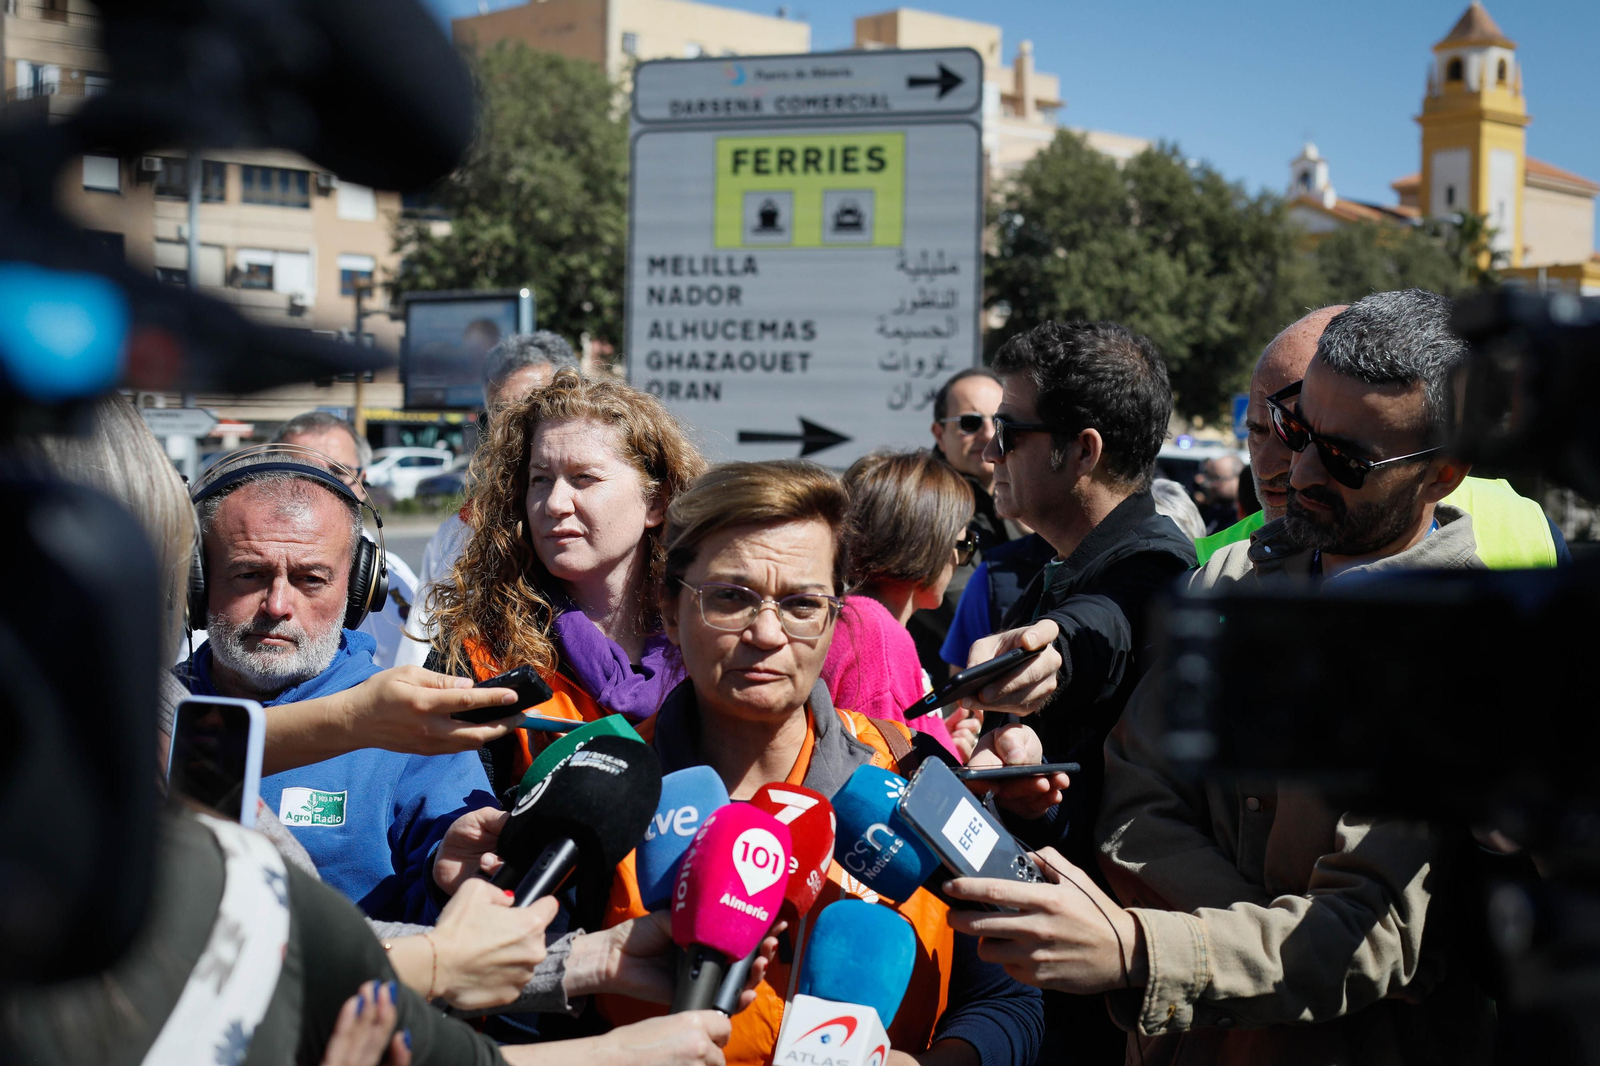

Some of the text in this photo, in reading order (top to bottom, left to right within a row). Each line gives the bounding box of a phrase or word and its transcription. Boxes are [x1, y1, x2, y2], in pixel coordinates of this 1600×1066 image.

[774, 93, 891, 114] COMERCIAL
[731, 145, 888, 176] FERRIES
[647, 255, 759, 277] MELILLA
[646, 284, 743, 307] NADOR
[647, 319, 818, 342] ALHUCEMAS
[646, 350, 812, 373] GHAZAOUET
[645, 379, 722, 402] ORAN
[285, 811, 342, 823] Agro Radio
[741, 840, 780, 875] 101
[864, 838, 904, 880] Noticias
[719, 892, 769, 921] Almería
